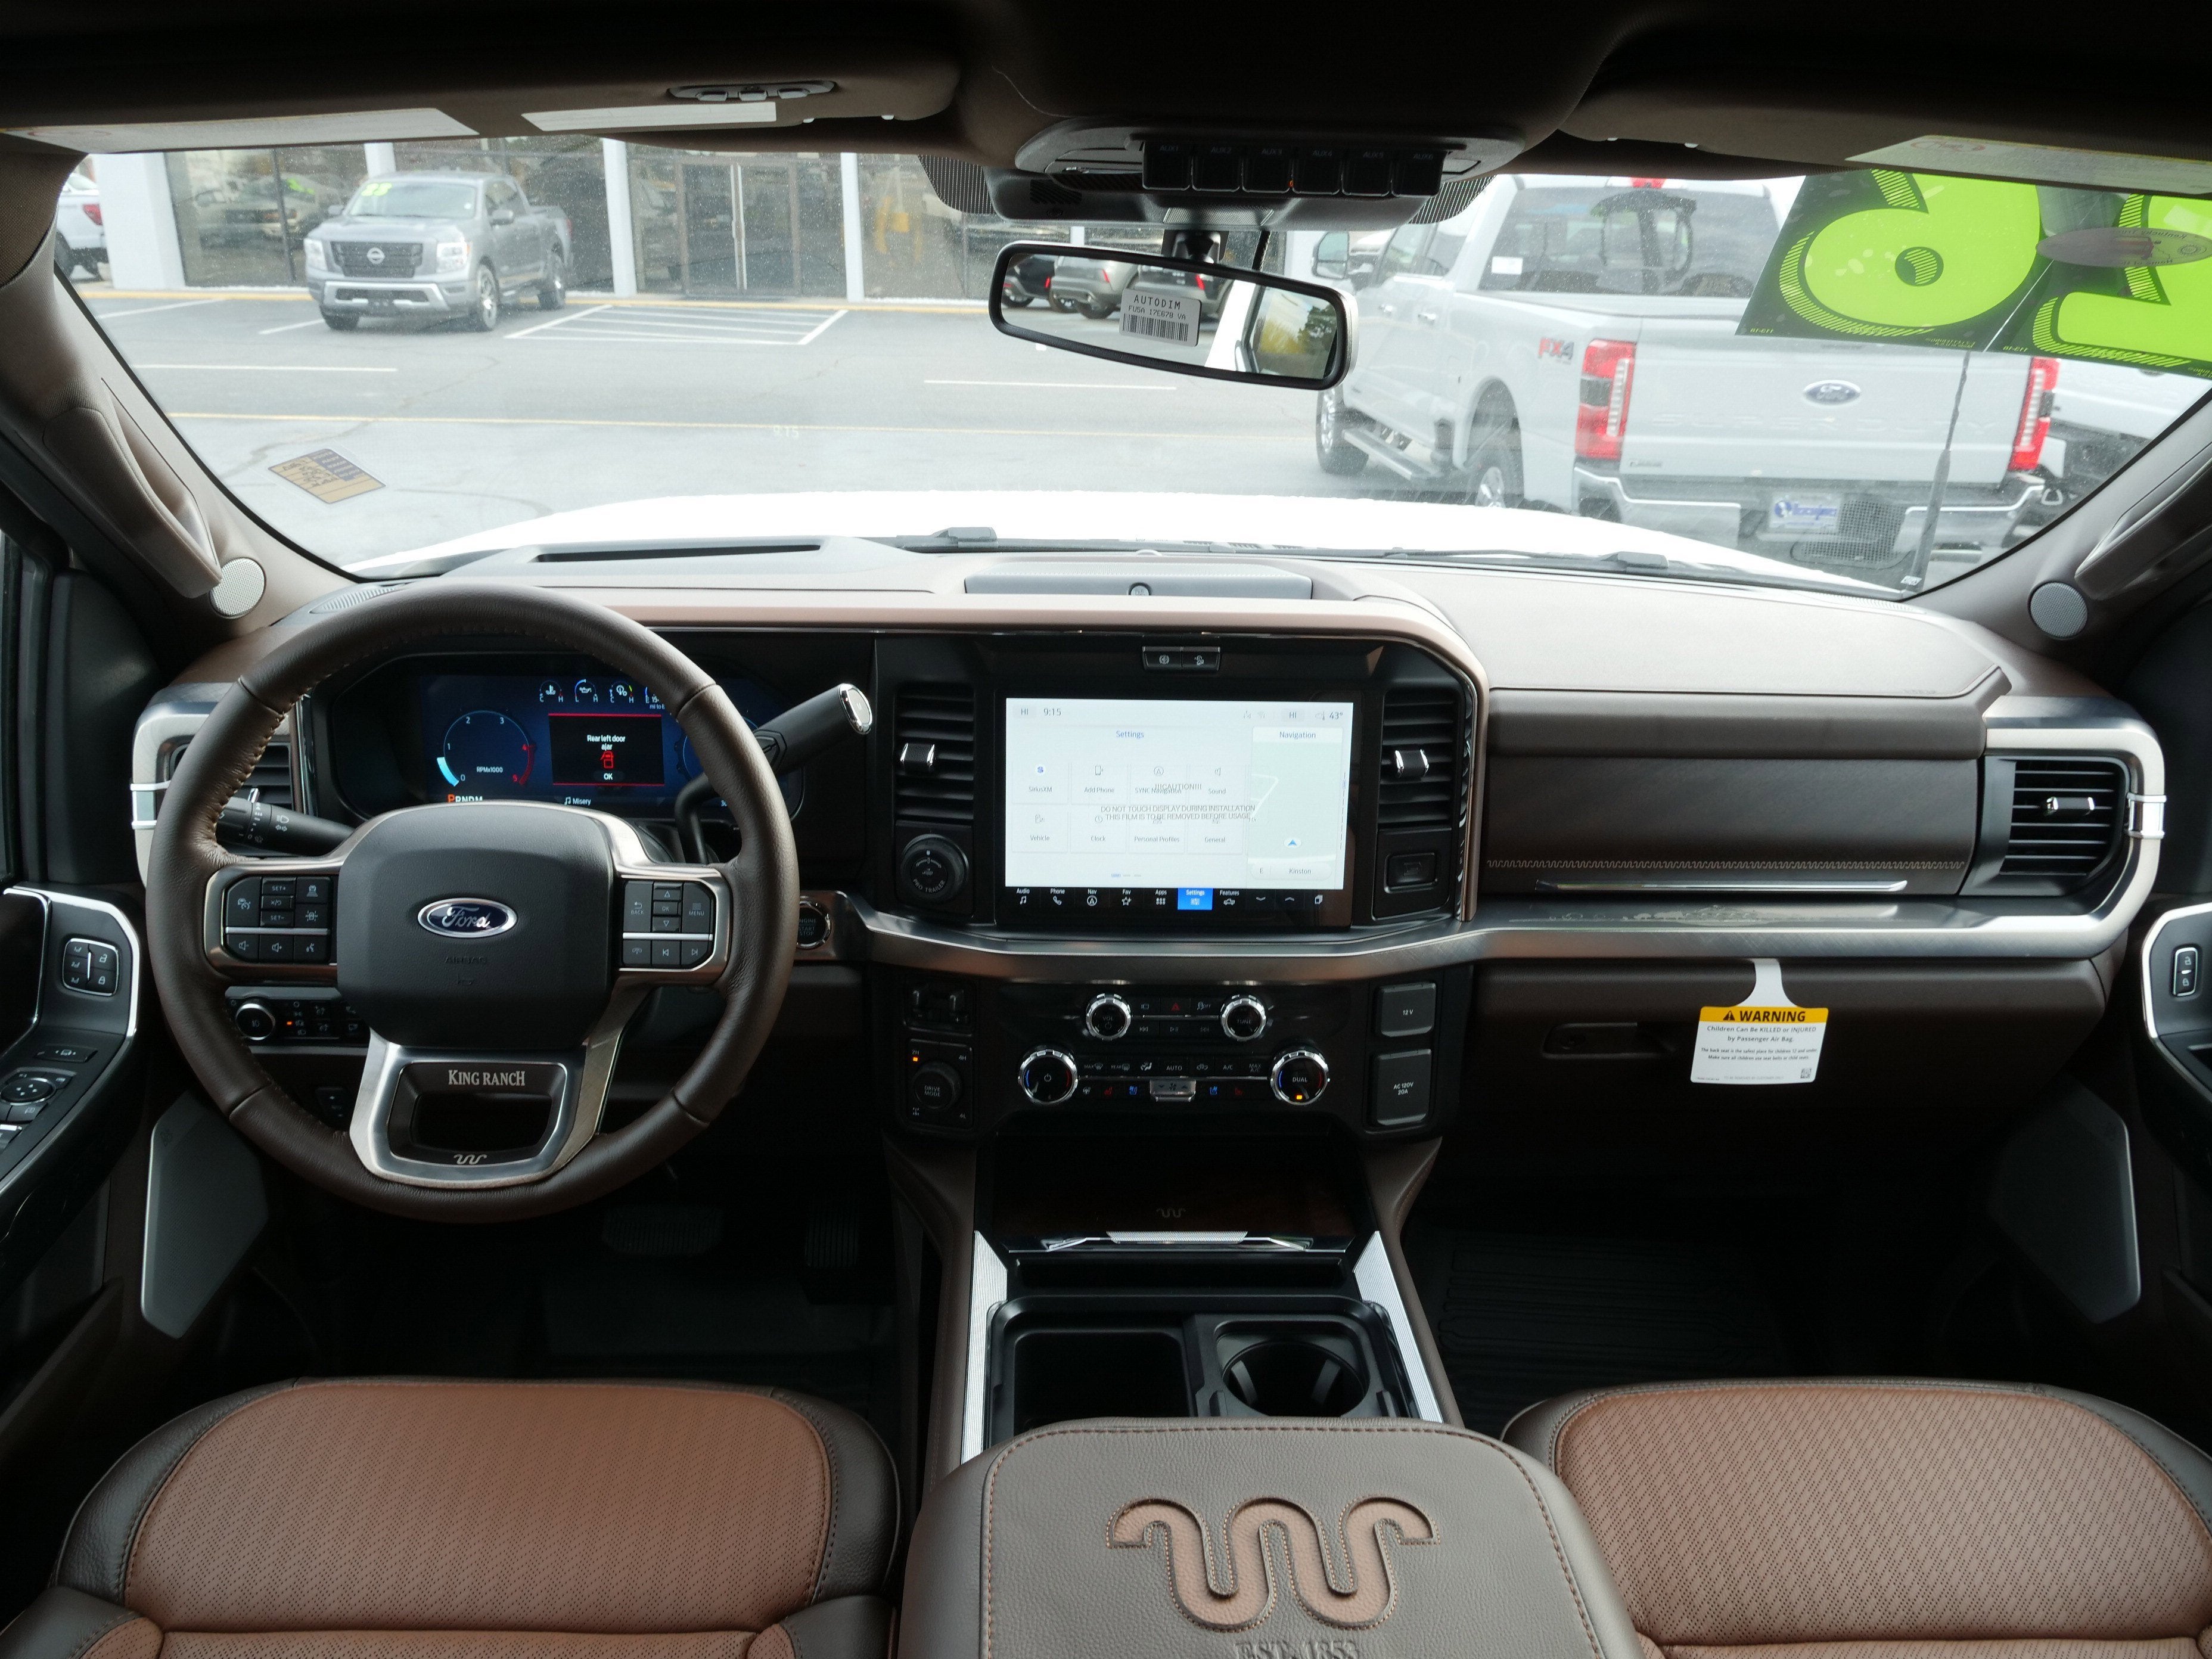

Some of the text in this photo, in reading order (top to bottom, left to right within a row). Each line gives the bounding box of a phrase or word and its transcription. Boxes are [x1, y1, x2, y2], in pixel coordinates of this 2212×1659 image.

[1133, 294, 1180, 310] AUTODIM
[1537, 337, 1574, 360] FX4
[1043, 708, 1062, 716] 9:15
[1116, 730, 1144, 739] Settings
[1279, 731, 1316, 740] Navigation
[601, 742, 613, 751] ajar
[512, 774, 517, 782] 5
[573, 797, 591, 806] Misery
[442, 906, 492, 928] Ford
[1739, 1010, 1806, 1022] WARNING
[448, 1069, 526, 1086] KING RANCH
